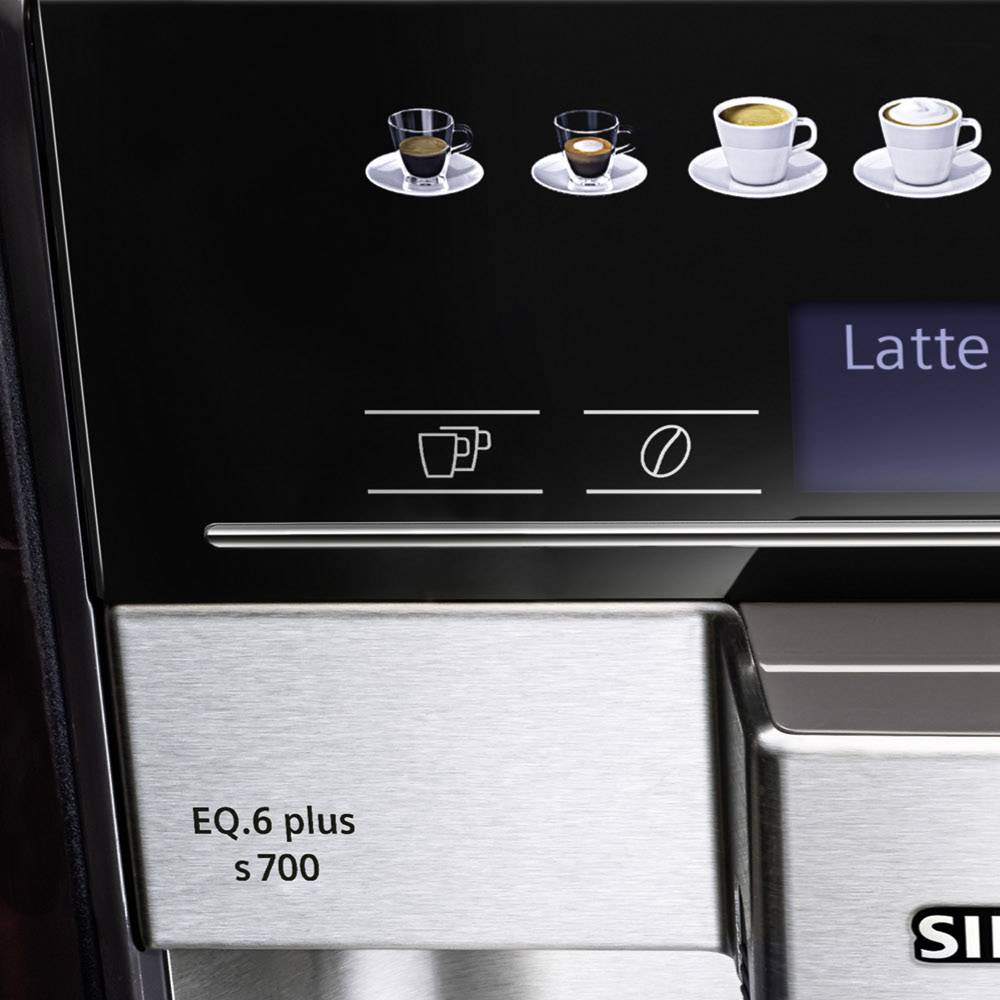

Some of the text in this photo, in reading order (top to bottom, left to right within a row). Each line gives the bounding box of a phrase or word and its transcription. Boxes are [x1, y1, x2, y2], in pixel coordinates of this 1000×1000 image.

[844, 322, 990, 371] Latte
[192, 804, 356, 844] EQ.6 plus
